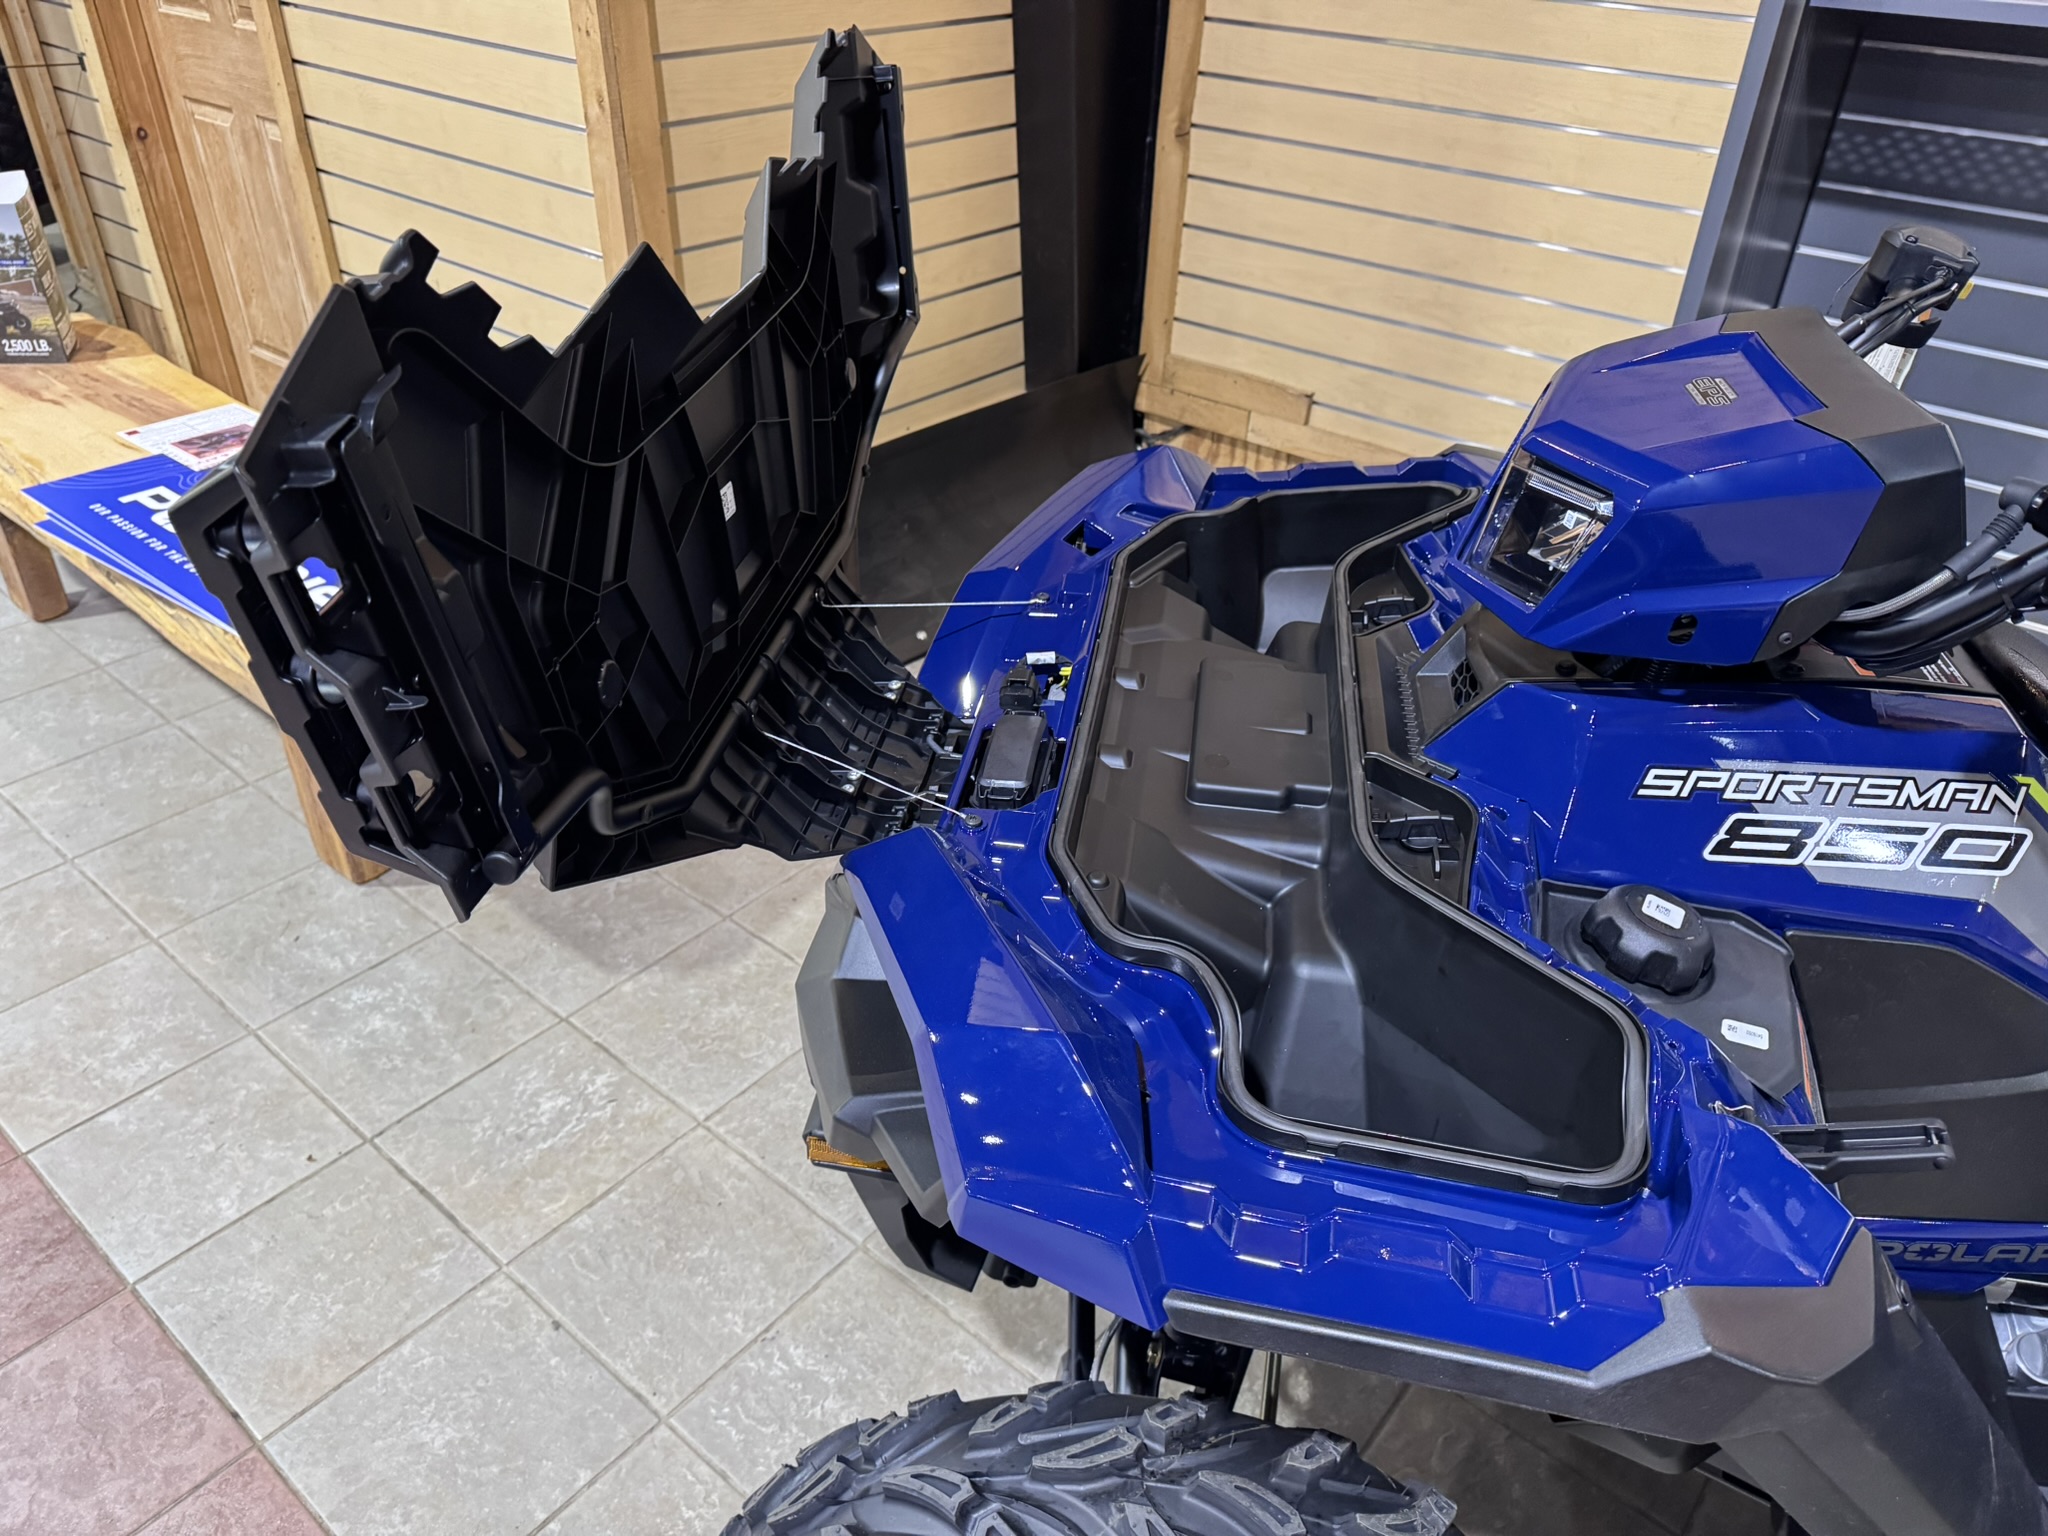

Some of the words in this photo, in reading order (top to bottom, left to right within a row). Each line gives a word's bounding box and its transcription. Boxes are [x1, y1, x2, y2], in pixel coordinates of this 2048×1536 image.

[1, 338, 33, 353] 2,500
[33, 338, 53, 352] LB.
[1692, 376, 1732, 407] EPS
[88, 503, 112, 516] OUR
[106, 514, 149, 539] PASSION
[143, 537, 168, 551] FOR
[163, 549, 188, 564] THE
[1636, 768, 2028, 813] SPORTSMAN
[1702, 813, 2034, 877] 850
